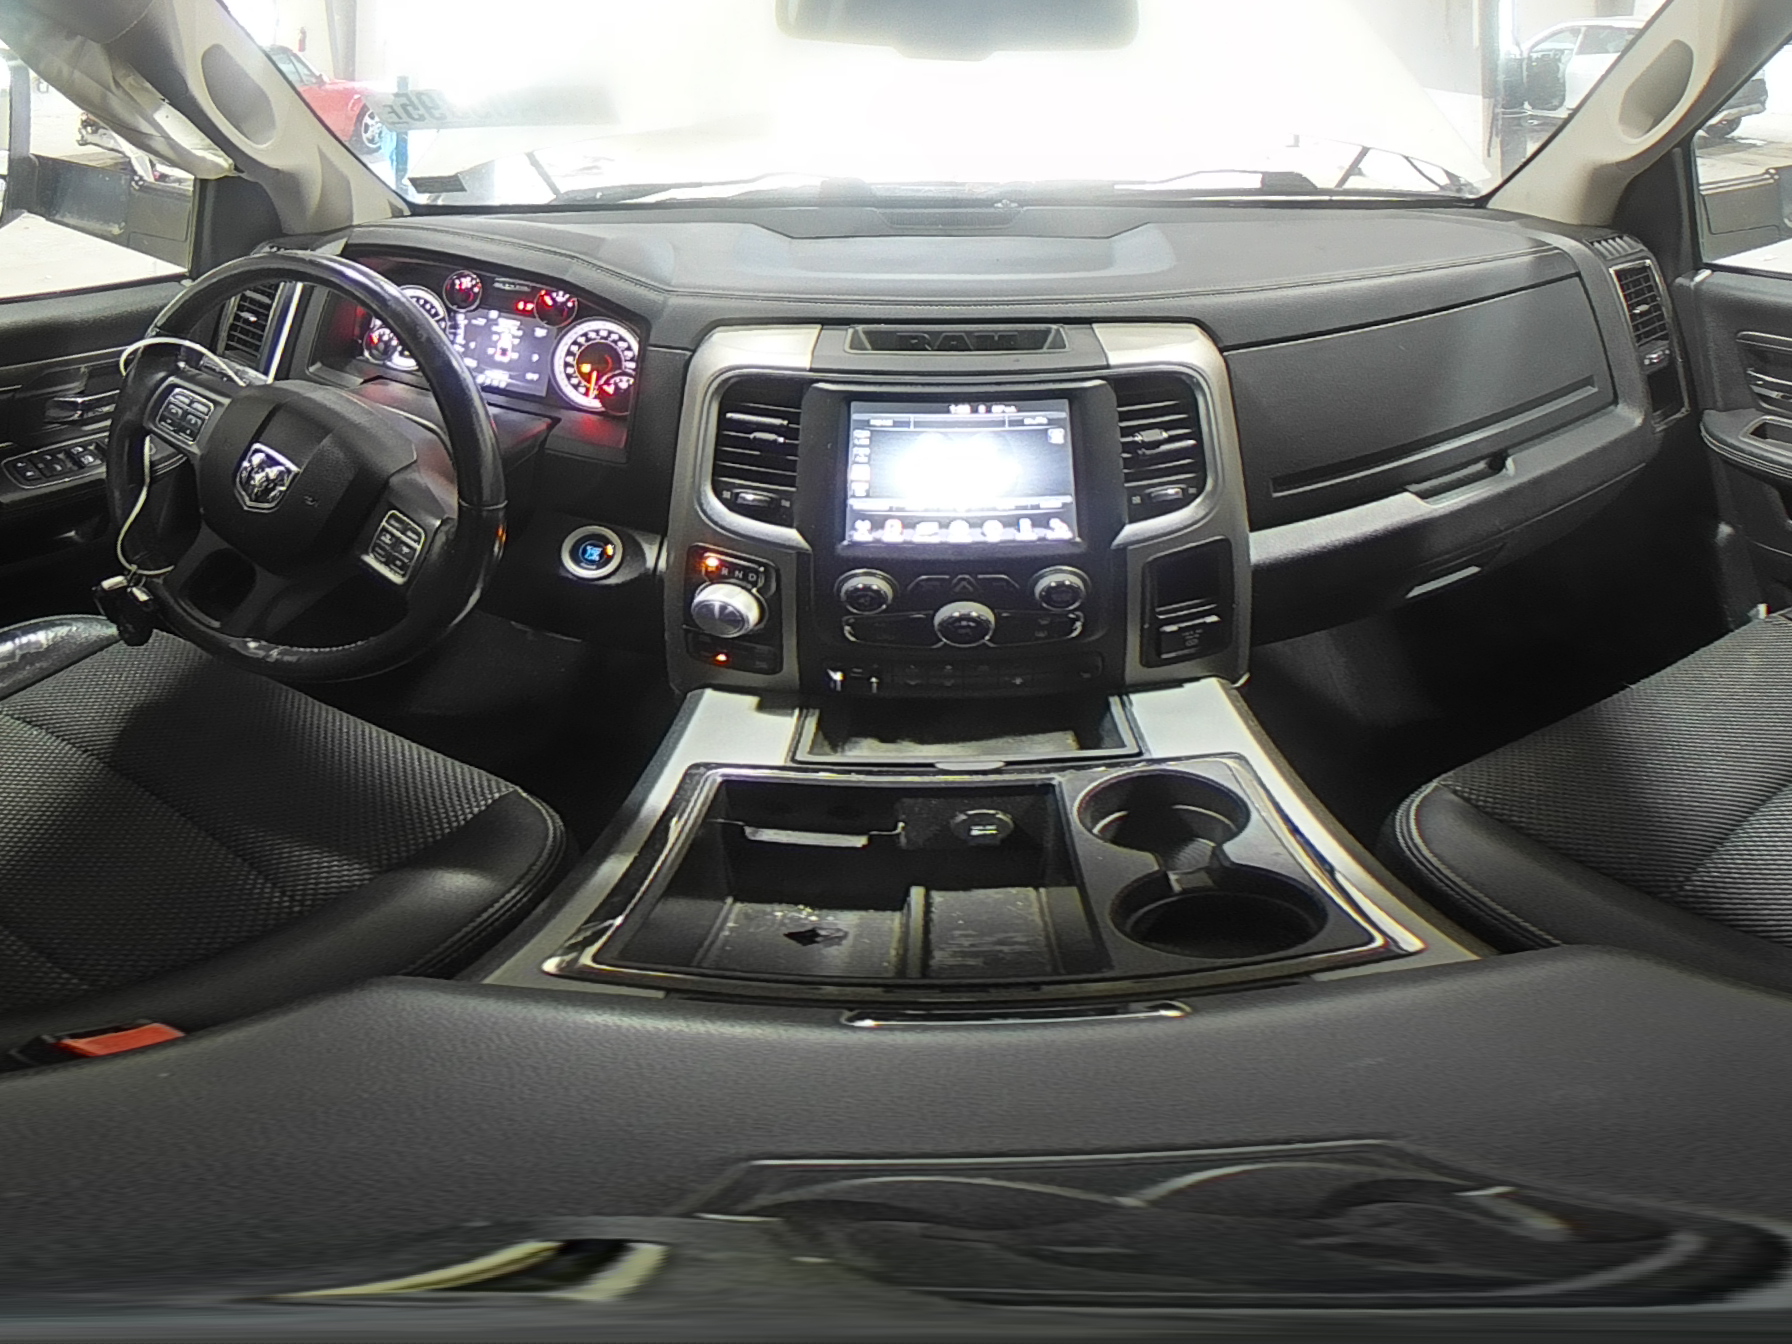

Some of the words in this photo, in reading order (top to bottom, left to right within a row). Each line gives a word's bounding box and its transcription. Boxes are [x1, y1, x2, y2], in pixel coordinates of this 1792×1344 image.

[895, 332, 1019, 351] RAM
[734, 570, 744, 579] N
[748, 573, 757, 582] D
